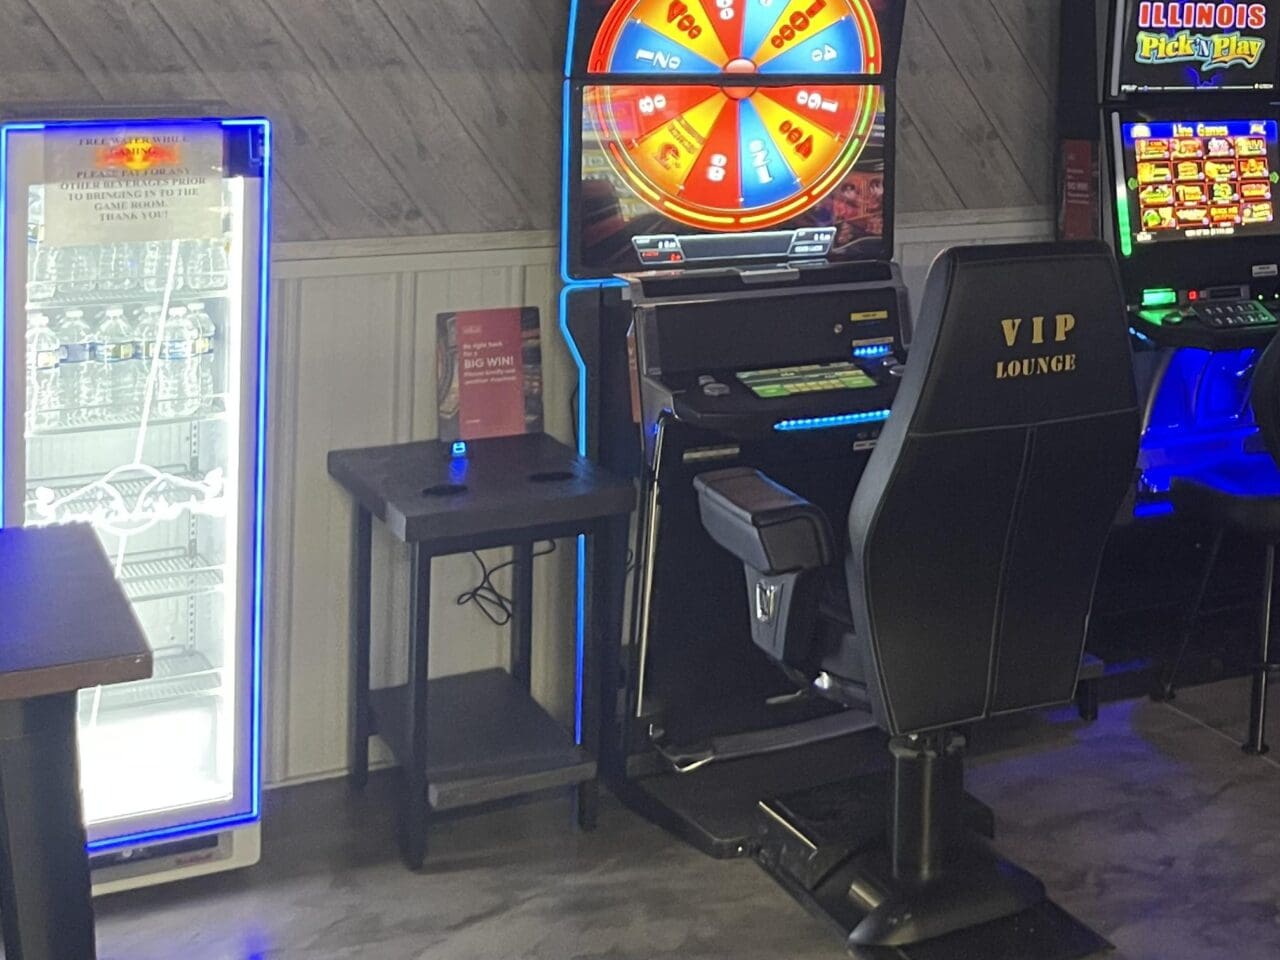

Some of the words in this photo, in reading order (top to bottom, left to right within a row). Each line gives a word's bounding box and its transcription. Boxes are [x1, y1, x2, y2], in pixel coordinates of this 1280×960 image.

[1138, 1, 1267, 29] ILLINOIS
[1138, 31, 1195, 60] Pick
[1213, 32, 1263, 64] Play
[172, 176, 206, 186] PRIOR
[86, 189, 142, 200] BRINGING
[94, 201, 128, 211] GAME
[100, 212, 138, 222] THANK
[1001, 313, 1075, 346] VIP
[464, 358, 485, 369] BIG
[486, 355, 514, 367] WIN!
[996, 353, 1076, 379] LOUNGE
